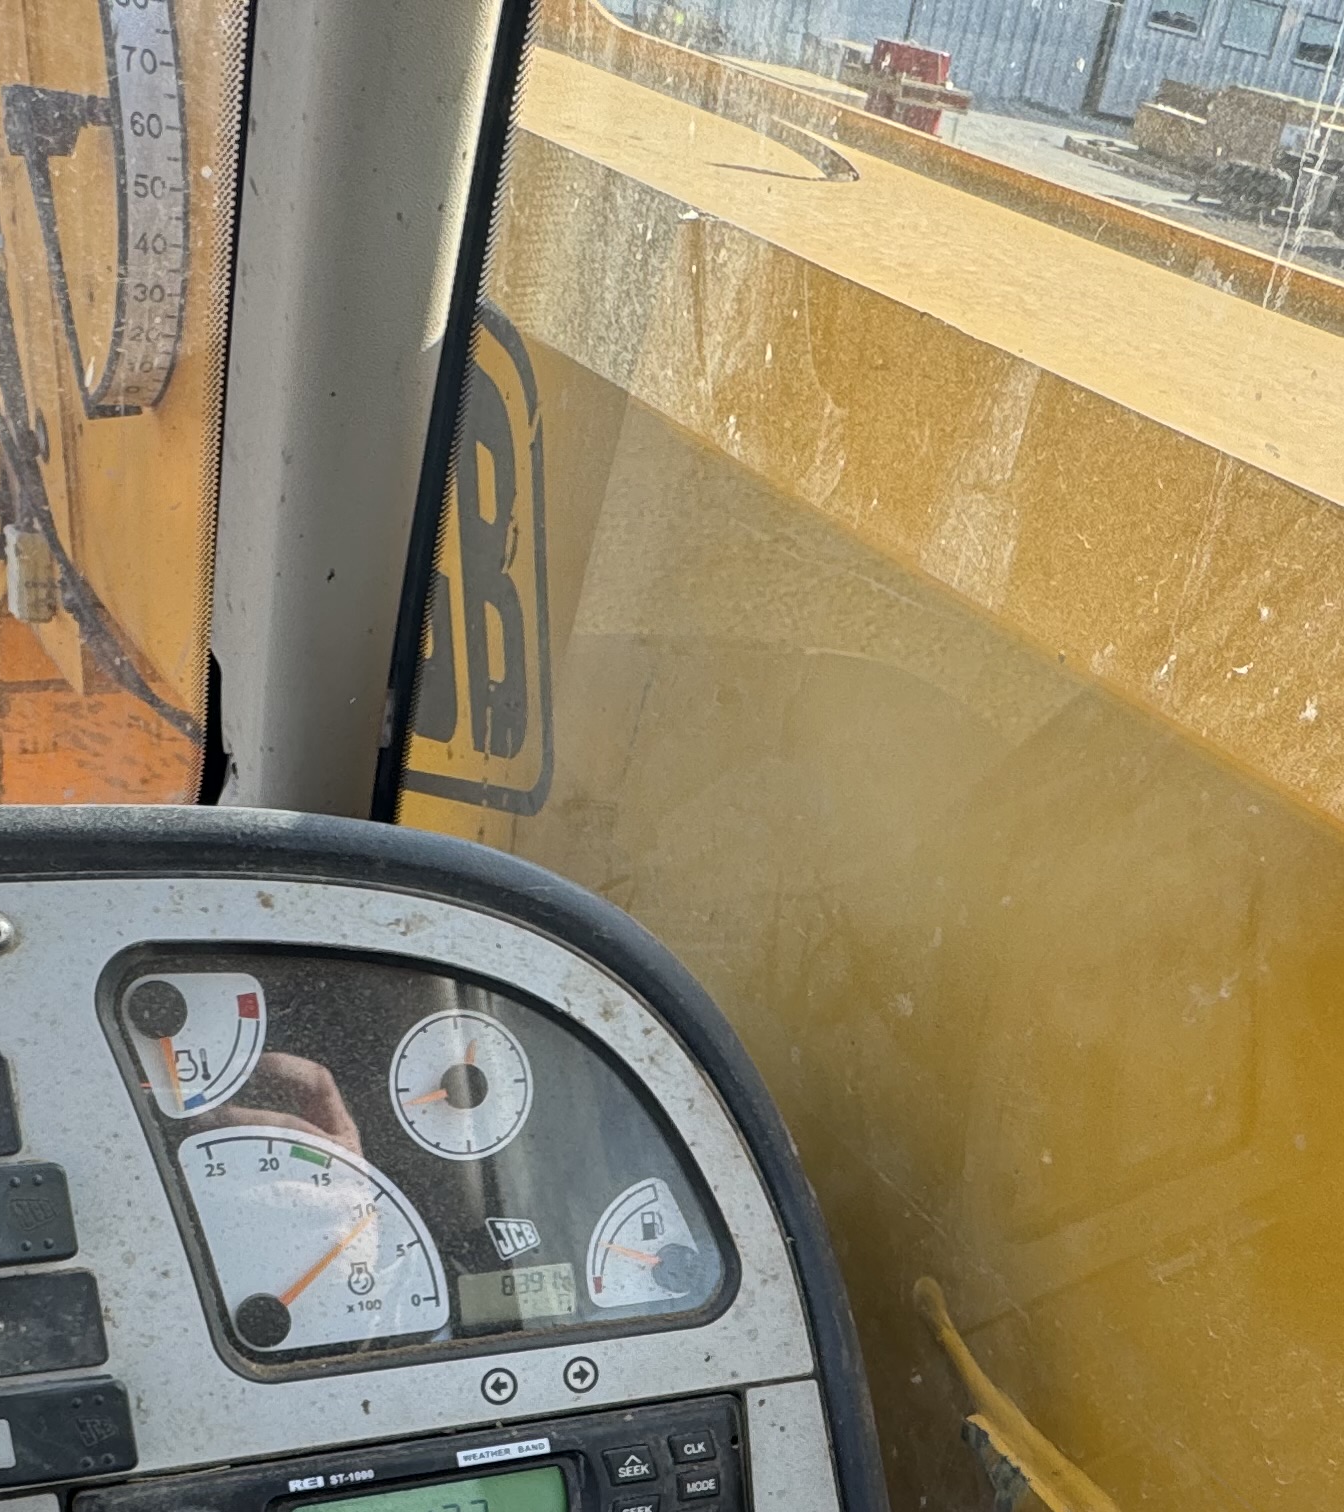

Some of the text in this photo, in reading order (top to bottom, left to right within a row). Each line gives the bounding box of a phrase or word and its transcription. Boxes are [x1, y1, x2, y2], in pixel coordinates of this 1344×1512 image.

[121, 45, 157, 75] 70
[130, 111, 164, 139] 60
[134, 174, 166, 199] 50
[134, 232, 168, 255] 40
[133, 283, 165, 303] 30
[129, 325, 162, 343] 20
[205, 1163, 226, 1178] 25
[258, 1157, 280, 1172] 20
[311, 1173, 332, 1187] 15
[353, 1202, 376, 1218] 10
[494, 1221, 537, 1256] JCB
[396, 1244, 405, 1258] 5
[358, 1299, 383, 1312] 100
[411, 1294, 421, 1307] 0
[462, 1443, 546, 1462] WEATHER BAND
[683, 1442, 706, 1454] CLK
[618, 1464, 650, 1478] SEEK
[289, 1475, 325, 1492] REI
[686, 1479, 716, 1493] MODE
